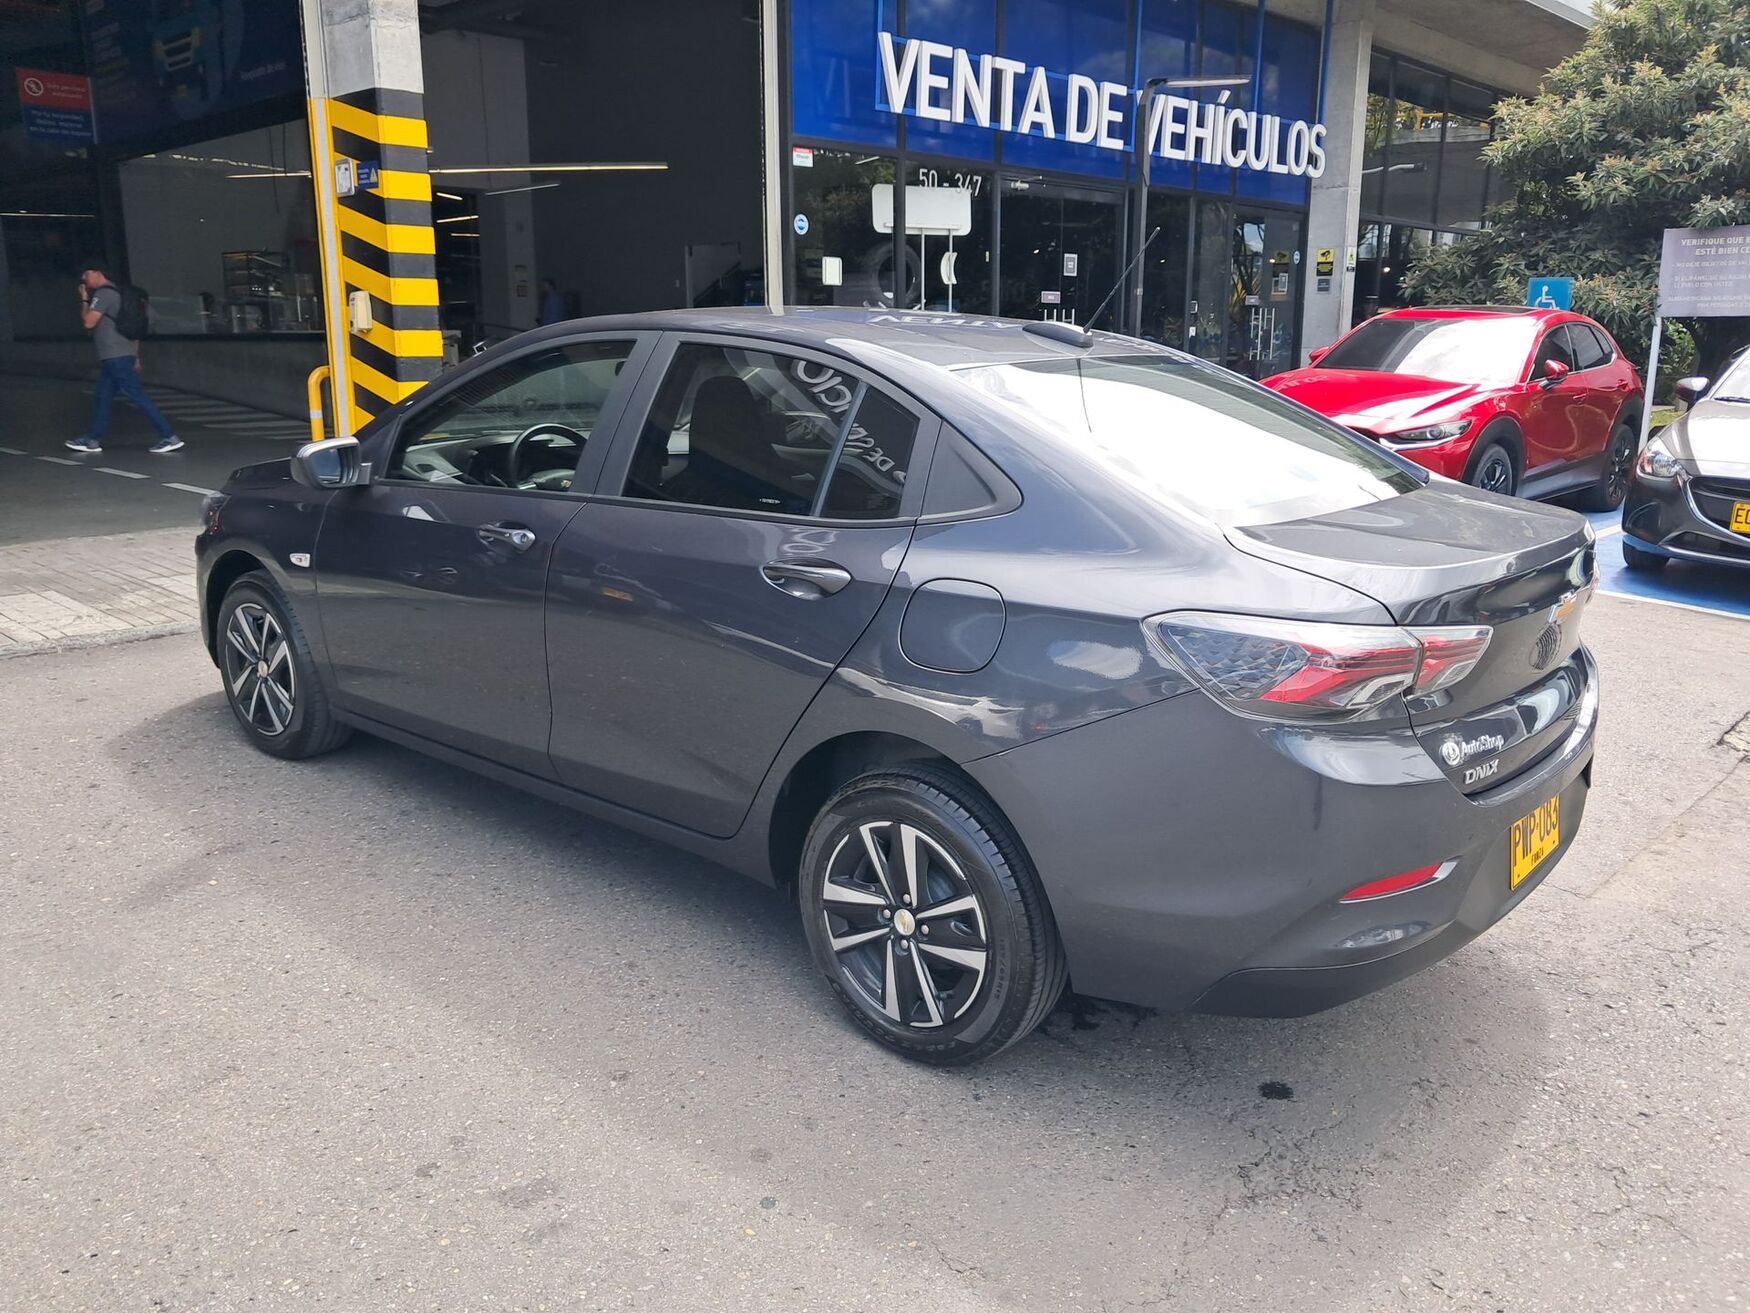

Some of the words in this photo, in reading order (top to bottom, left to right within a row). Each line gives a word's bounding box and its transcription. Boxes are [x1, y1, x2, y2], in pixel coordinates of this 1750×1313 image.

[878, 31, 1056, 138] VENTA
[1065, 73, 1128, 151] DE
[1136, 89, 1328, 178] VEHÍCULOS
[919, 168, 938, 189] 50
[954, 173, 982, 197] 347
[1681, 237, 1725, 246] VERIFIQUE
[1726, 236, 1745, 244] QUE
[1718, 247, 1738, 255] BIEN
